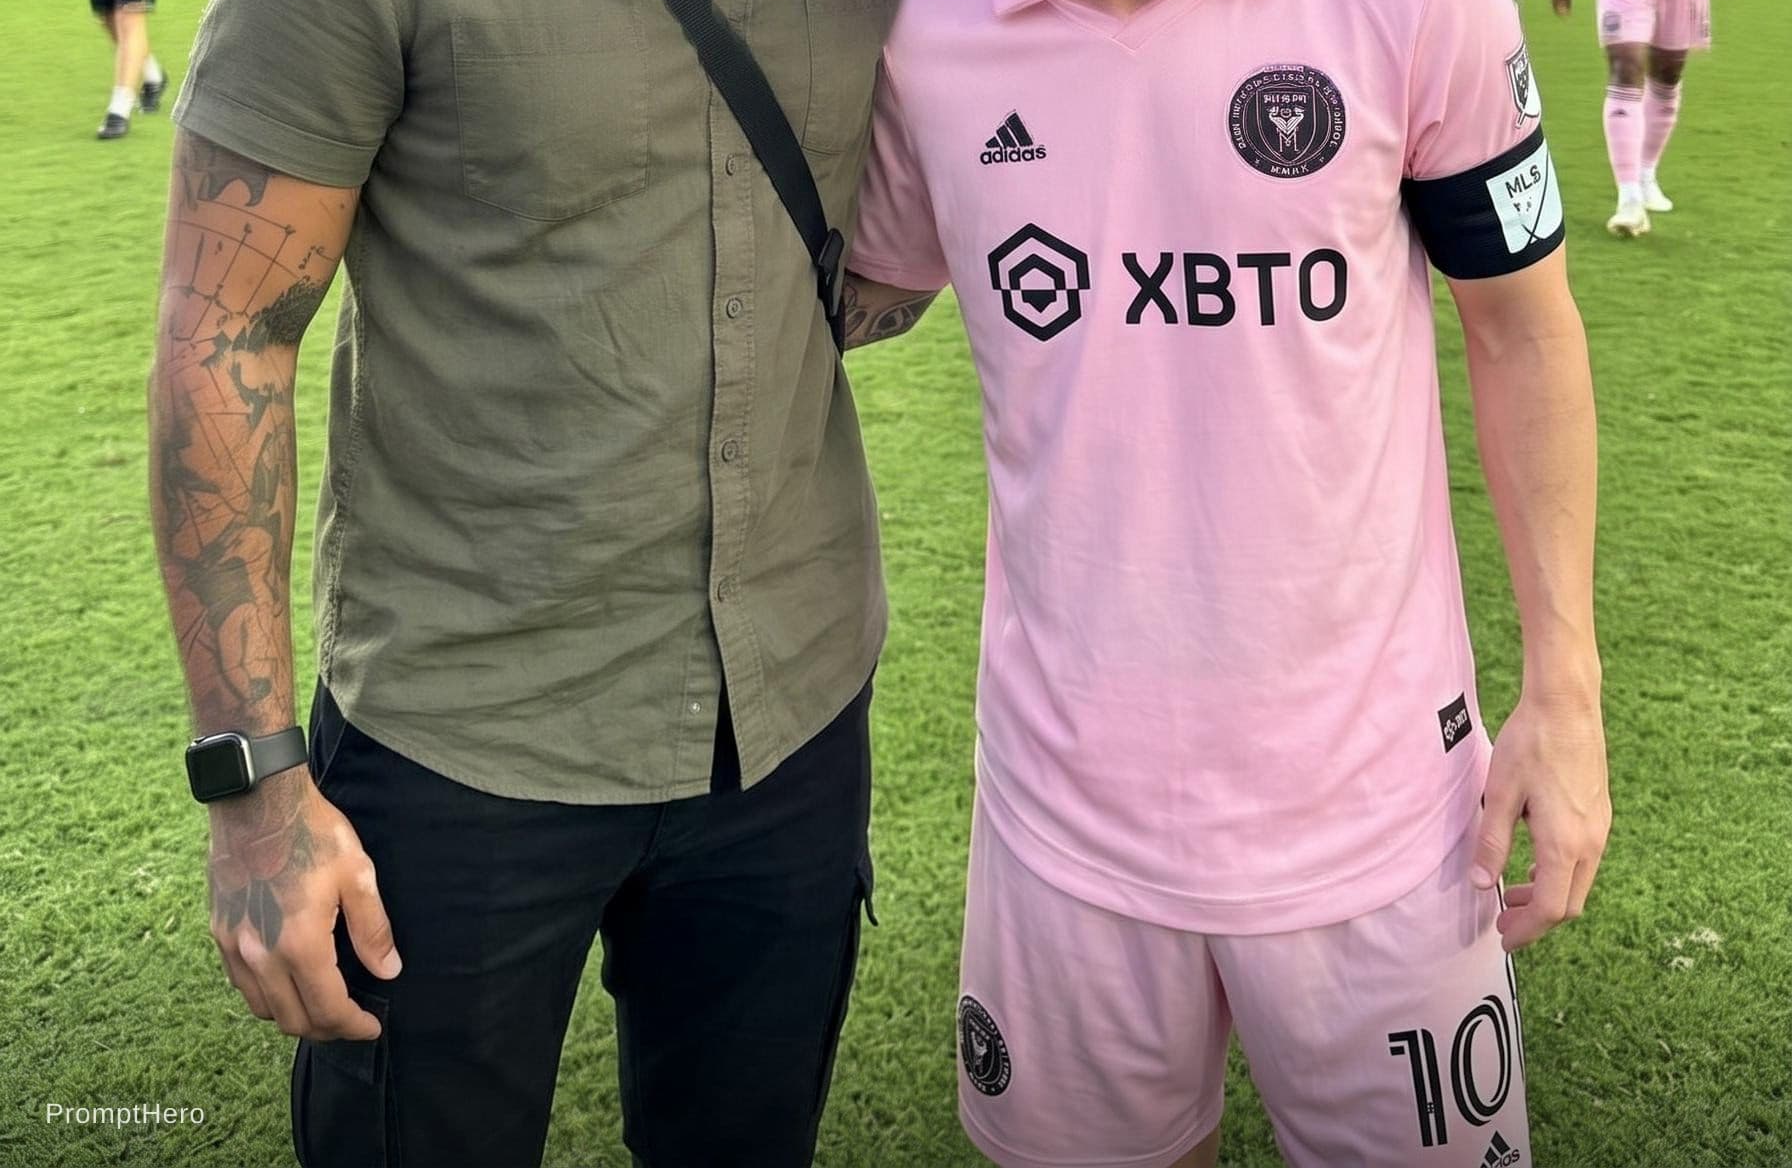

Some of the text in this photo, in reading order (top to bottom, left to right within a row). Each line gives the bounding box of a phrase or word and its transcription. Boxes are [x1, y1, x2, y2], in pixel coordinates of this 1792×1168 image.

[980, 146, 1047, 165] adidas
[1505, 164, 1542, 199] MLS
[1122, 248, 1347, 327] XBTO
[1388, 994, 1513, 1148] 10
